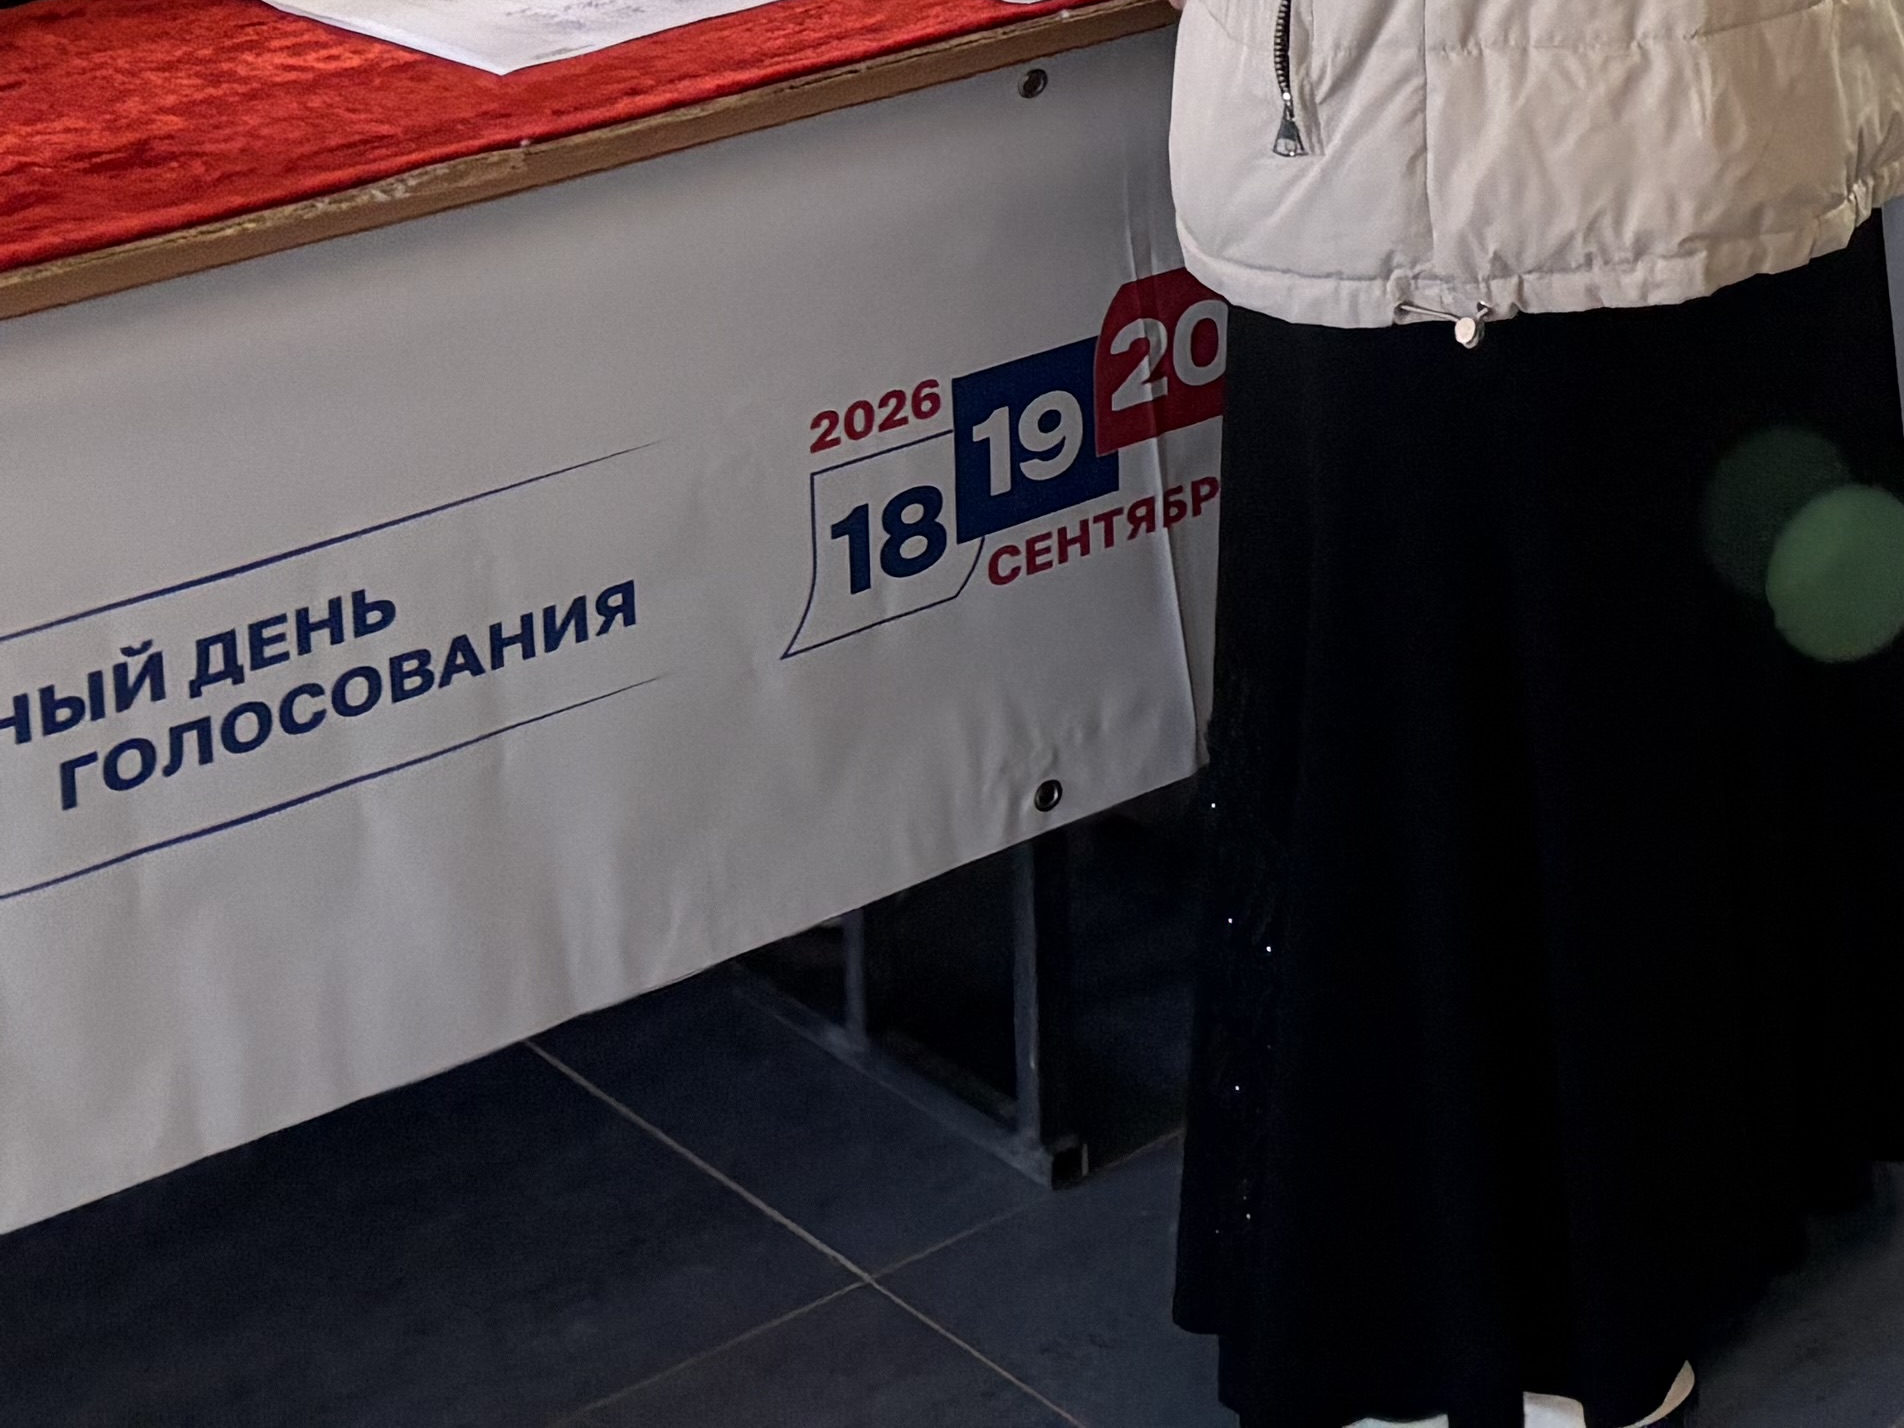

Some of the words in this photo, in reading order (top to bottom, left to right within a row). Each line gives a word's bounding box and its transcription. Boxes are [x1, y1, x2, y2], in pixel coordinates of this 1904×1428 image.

[809, 378, 942, 453] 2026
[830, 485, 948, 595] 18
[972, 390, 1084, 497] 19
[1110, 299, 1229, 411] 20
[987, 476, 1220, 586] СЕНТЯБР
[0, 638, 167, 745] НЫЙ
[188, 588, 397, 699] ДЕНЬ
[59, 578, 640, 811] ГОЛОСОВАНИЯ
